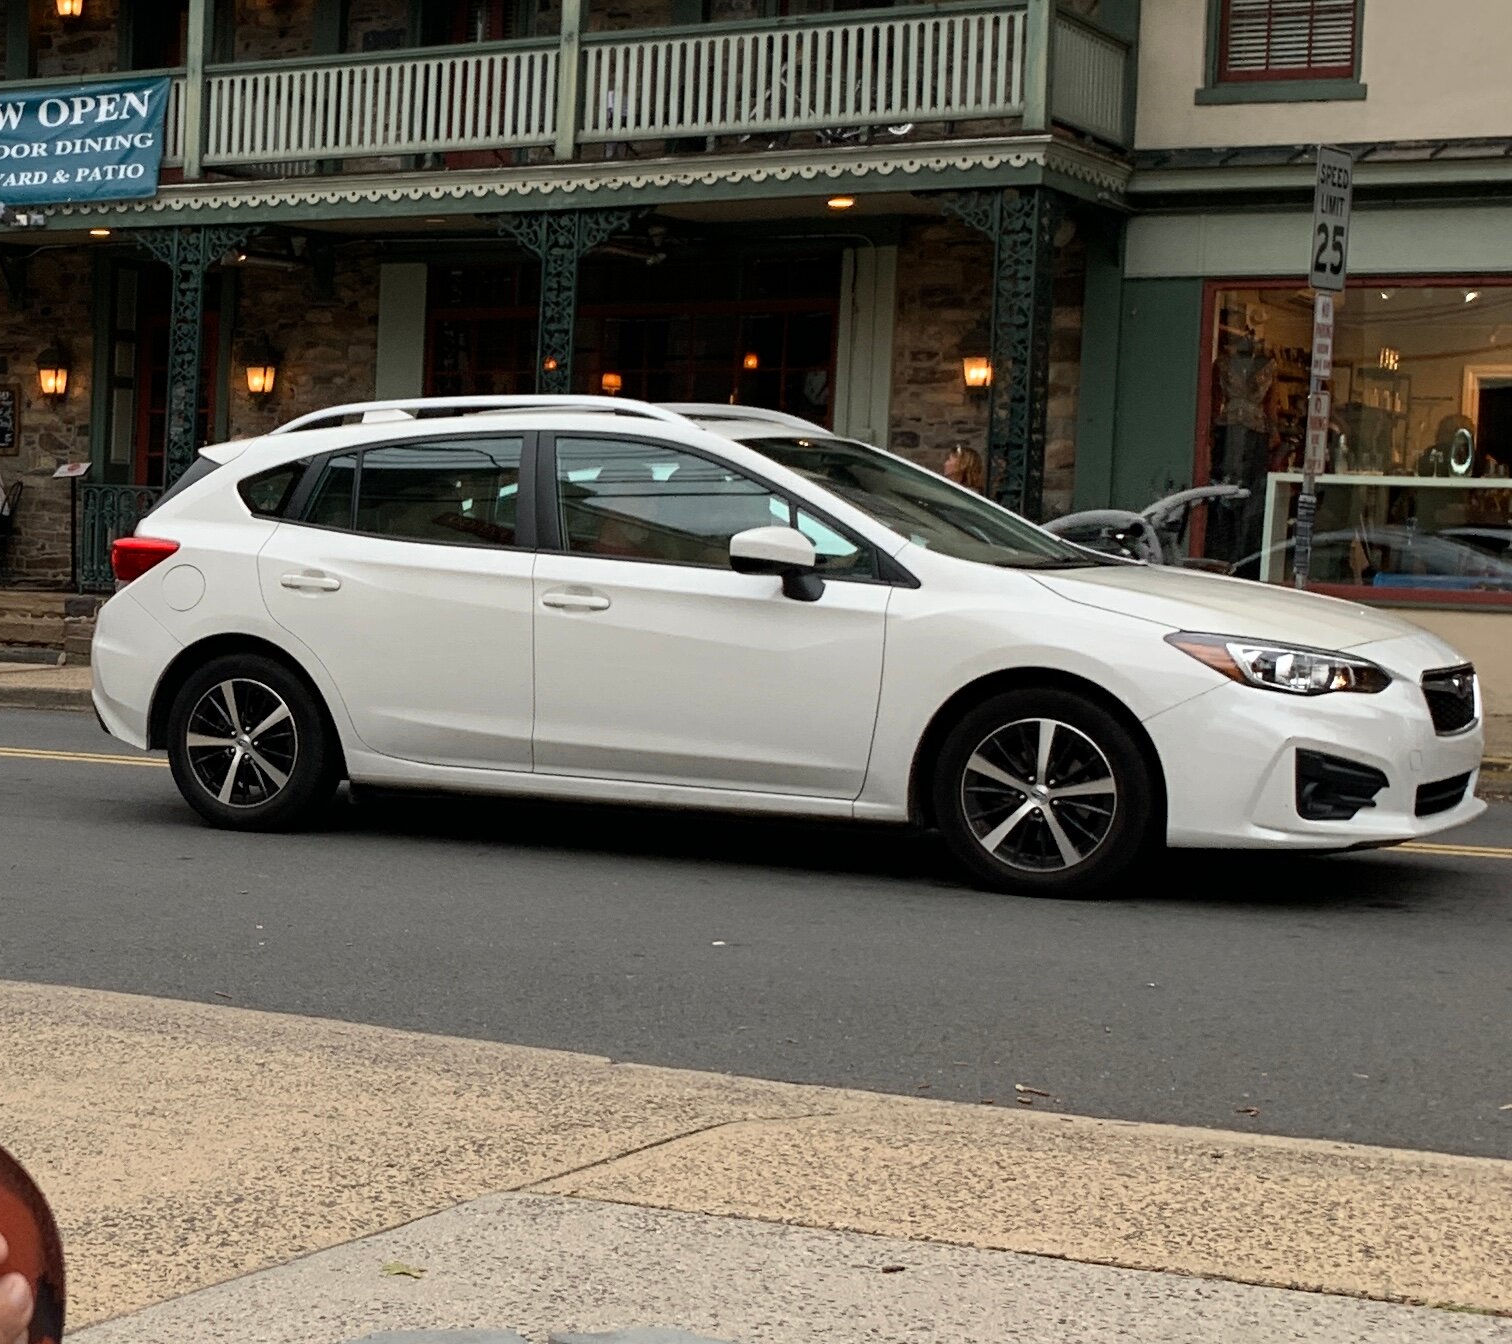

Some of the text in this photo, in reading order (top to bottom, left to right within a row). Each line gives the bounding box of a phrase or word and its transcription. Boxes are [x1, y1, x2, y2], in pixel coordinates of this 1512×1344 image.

[38, 89, 153, 128] OPEN
[55, 132, 154, 156] DINING
[52, 169, 70, 184] &
[75, 163, 145, 183] PATIO
[1320, 163, 1349, 189] SPEED
[1320, 194, 1346, 216] LIMIT
[1314, 222, 1345, 275] 25
